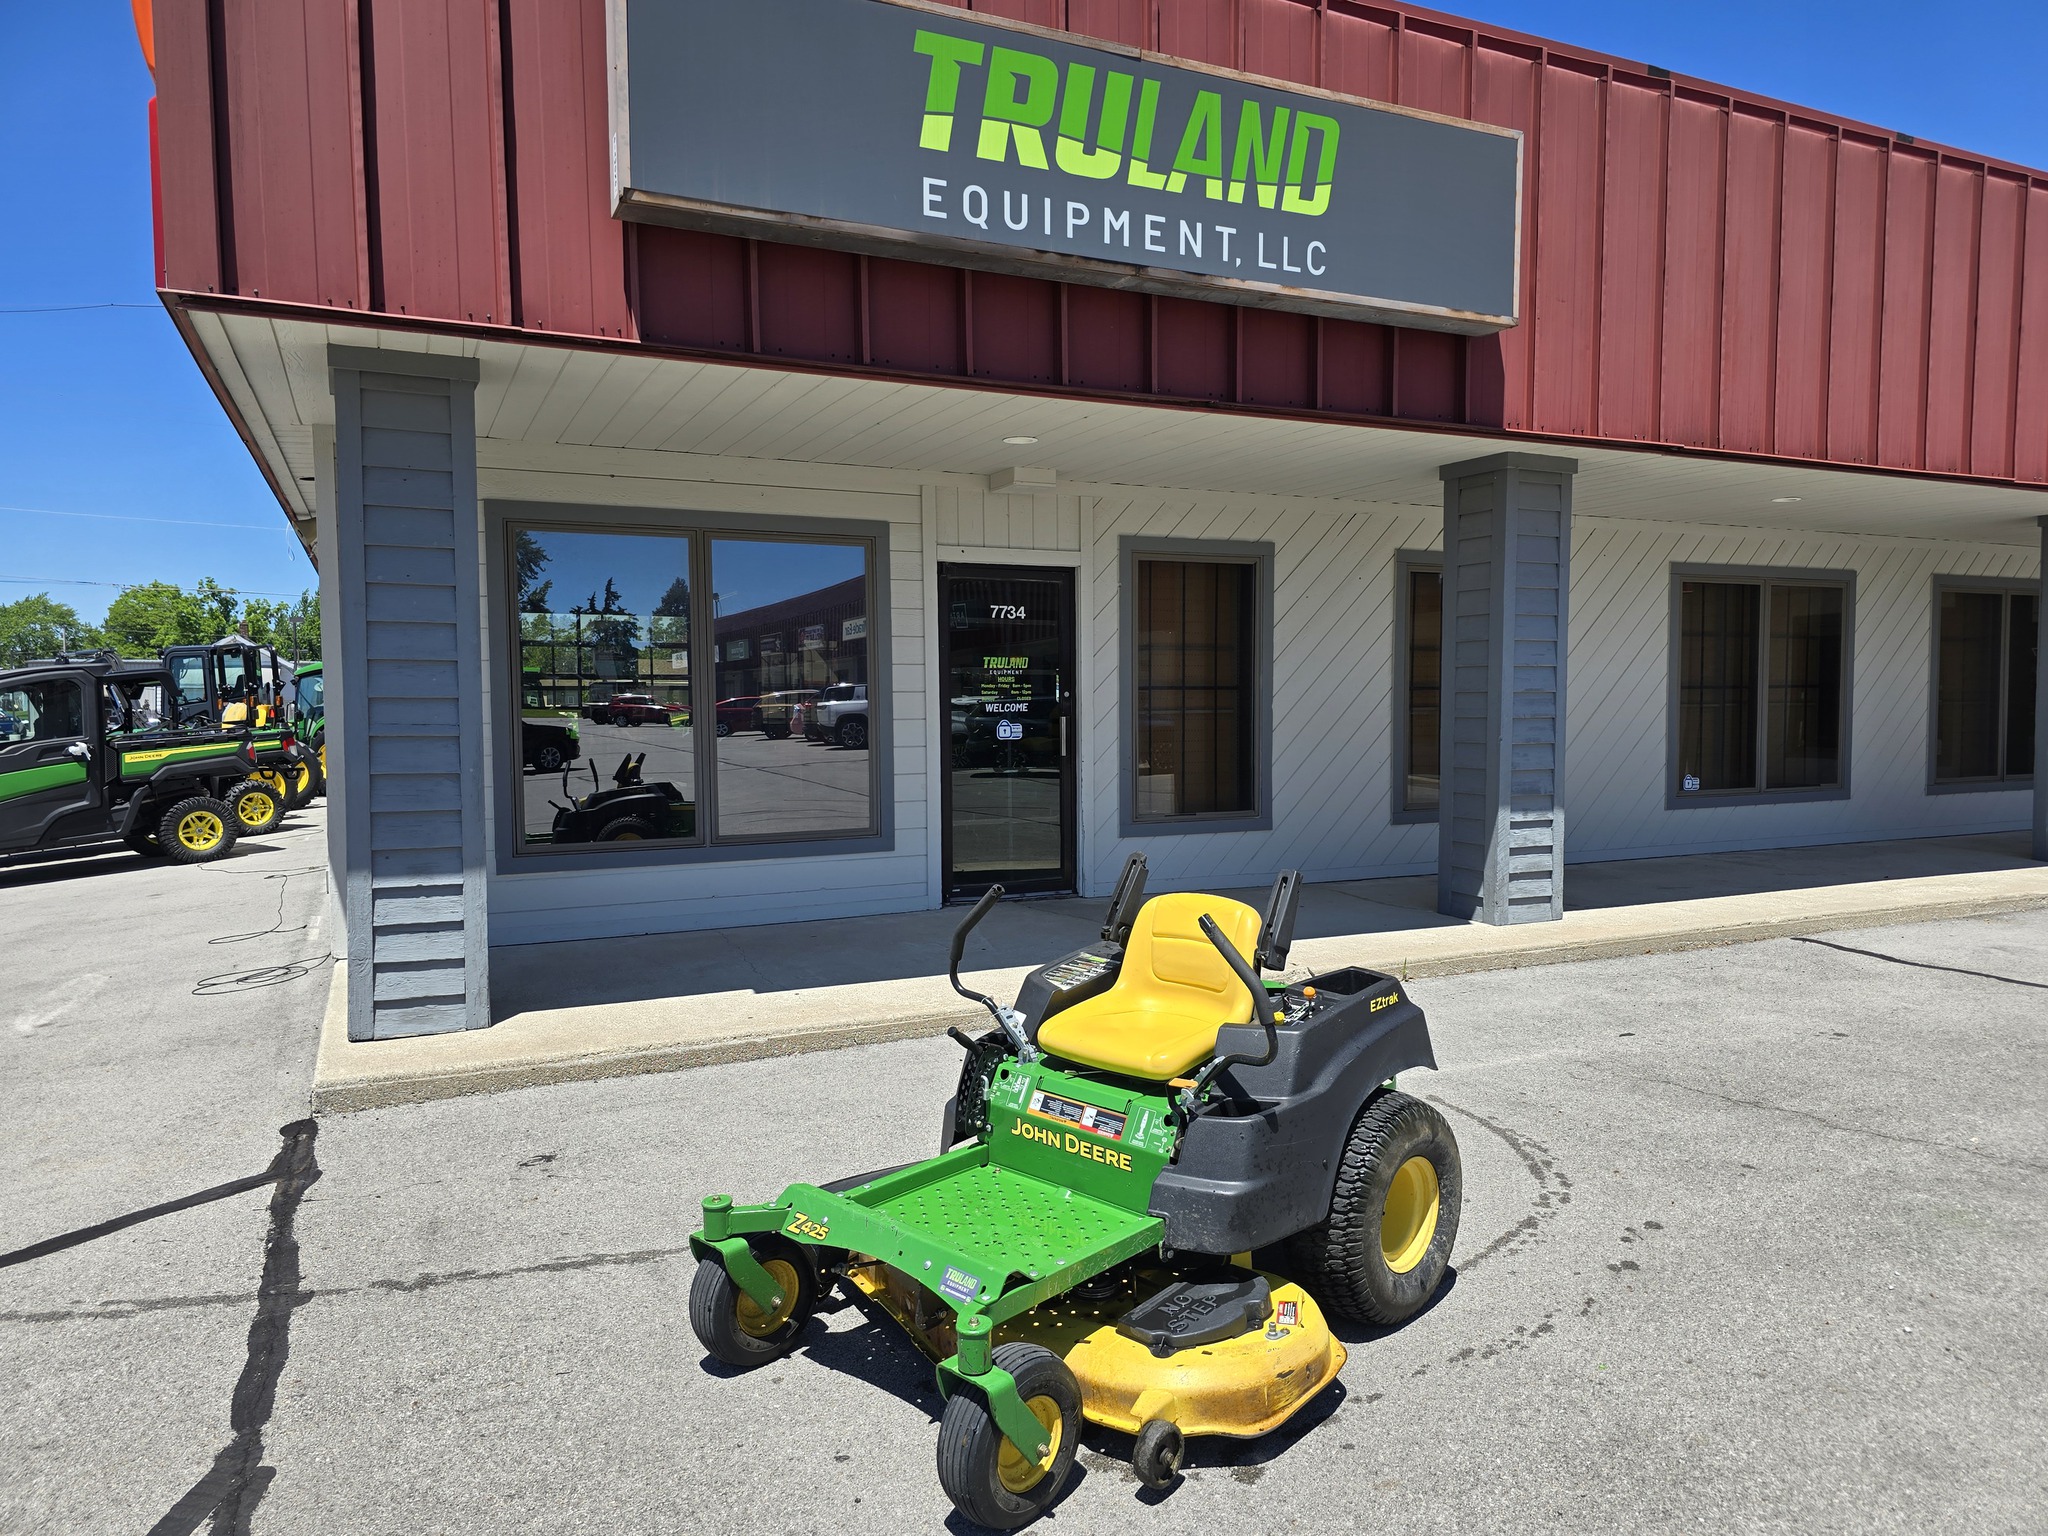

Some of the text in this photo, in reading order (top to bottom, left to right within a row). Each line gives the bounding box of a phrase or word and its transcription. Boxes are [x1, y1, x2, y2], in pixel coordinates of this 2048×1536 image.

[913, 29, 1340, 216] TRULAND
[923, 177, 1327, 275] EQUIPMENT, LLC
[990, 605, 1026, 619] 7734
[983, 657, 1029, 669] TRULAND
[985, 703, 1029, 712] WELCOME
[1370, 992, 1399, 1013] EZtrak
[1011, 1117, 1061, 1149] JOHN
[1064, 1132, 1133, 1172] DEERE
[786, 1210, 831, 1240] Z425
[945, 1268, 978, 1290] TRULAND
[946, 1280, 970, 1293] EQUIPMENT
[1158, 1294, 1192, 1317] NO
[1167, 1295, 1217, 1333] STEP
